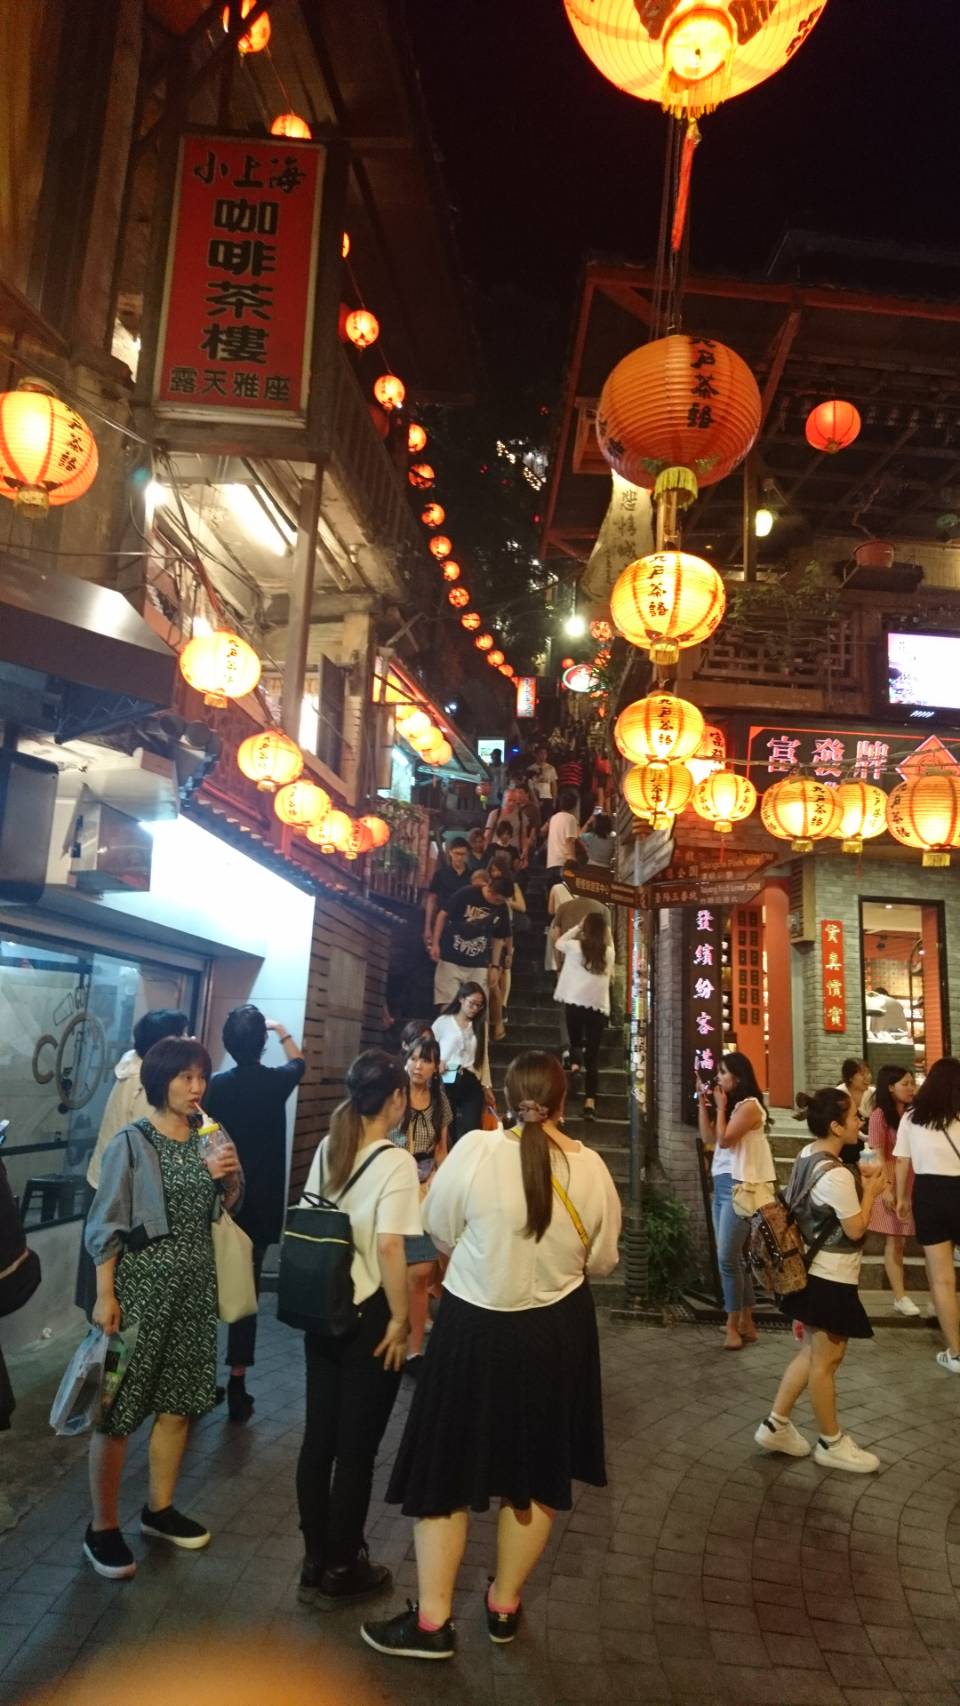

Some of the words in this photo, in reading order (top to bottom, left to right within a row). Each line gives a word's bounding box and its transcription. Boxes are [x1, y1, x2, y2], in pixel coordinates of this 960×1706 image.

[193, 152, 306, 194] 小上海
[201, 198, 280, 364] 咖啡茶樓
[170, 366, 290, 402] 露天雅座
[693, 909, 715, 1106] 發繽紛客滿
